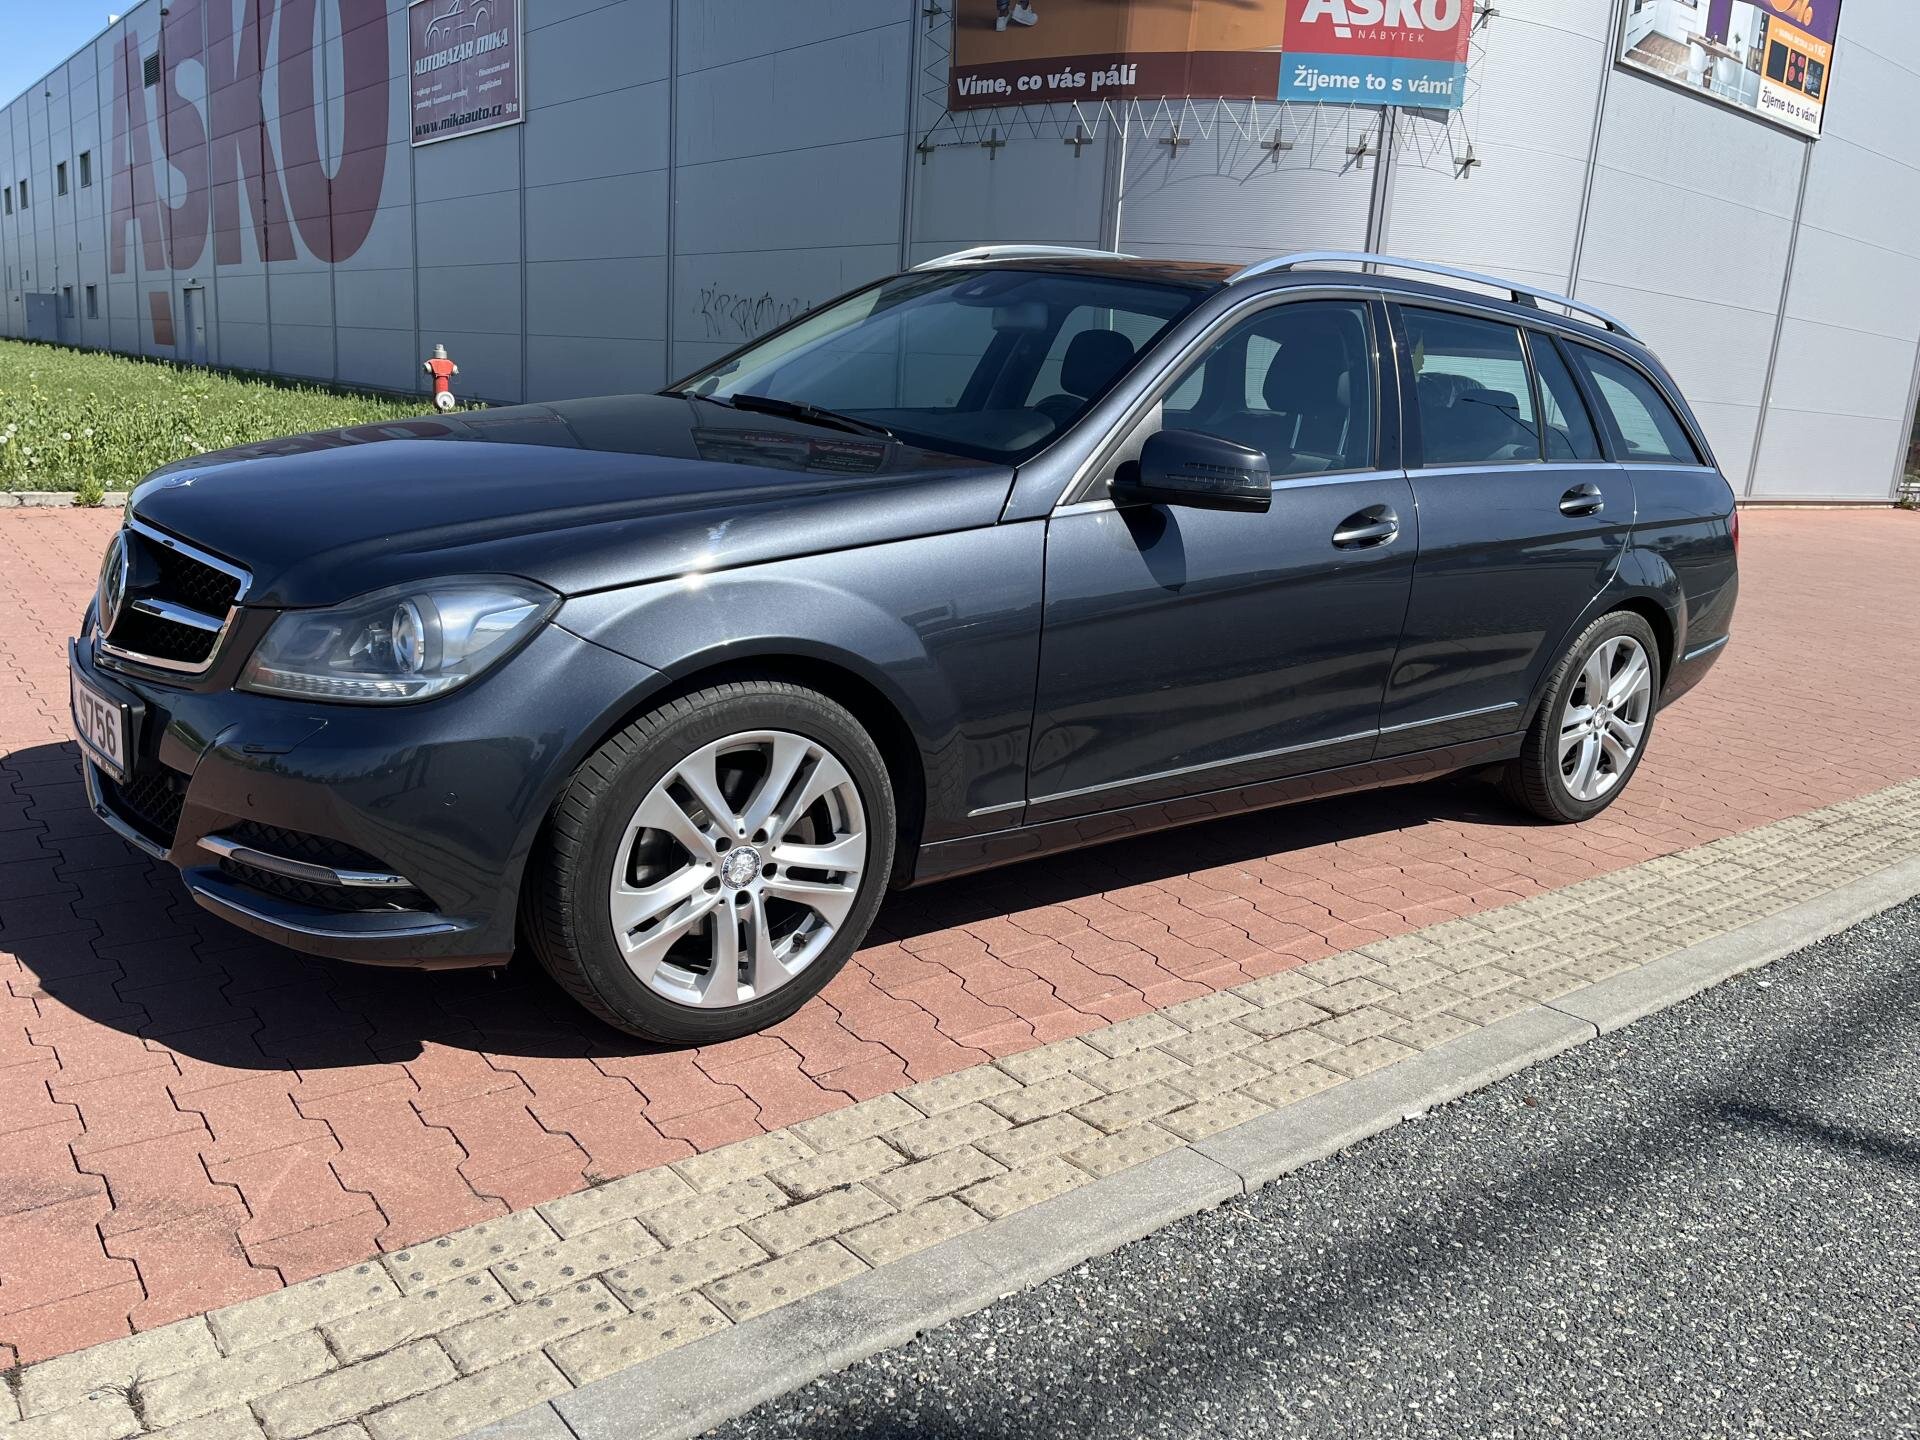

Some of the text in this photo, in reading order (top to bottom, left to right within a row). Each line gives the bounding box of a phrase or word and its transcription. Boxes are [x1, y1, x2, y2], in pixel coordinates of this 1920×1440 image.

[1300, 0, 1461, 32] ASKO
[414, 28, 508, 76] AUTOBAZAR MIKA
[1358, 30, 1424, 43] NÁBYTEK
[957, 64, 1137, 96] Víme, co vás pálí
[1293, 65, 1454, 95] Žijeme to s vámi
[415, 104, 502, 136] www.mikaauto.cz
[1762, 86, 1818, 124] Žijeme to s vámi
[110, 0, 390, 275] ASKO
[80, 690, 116, 757] 9756
